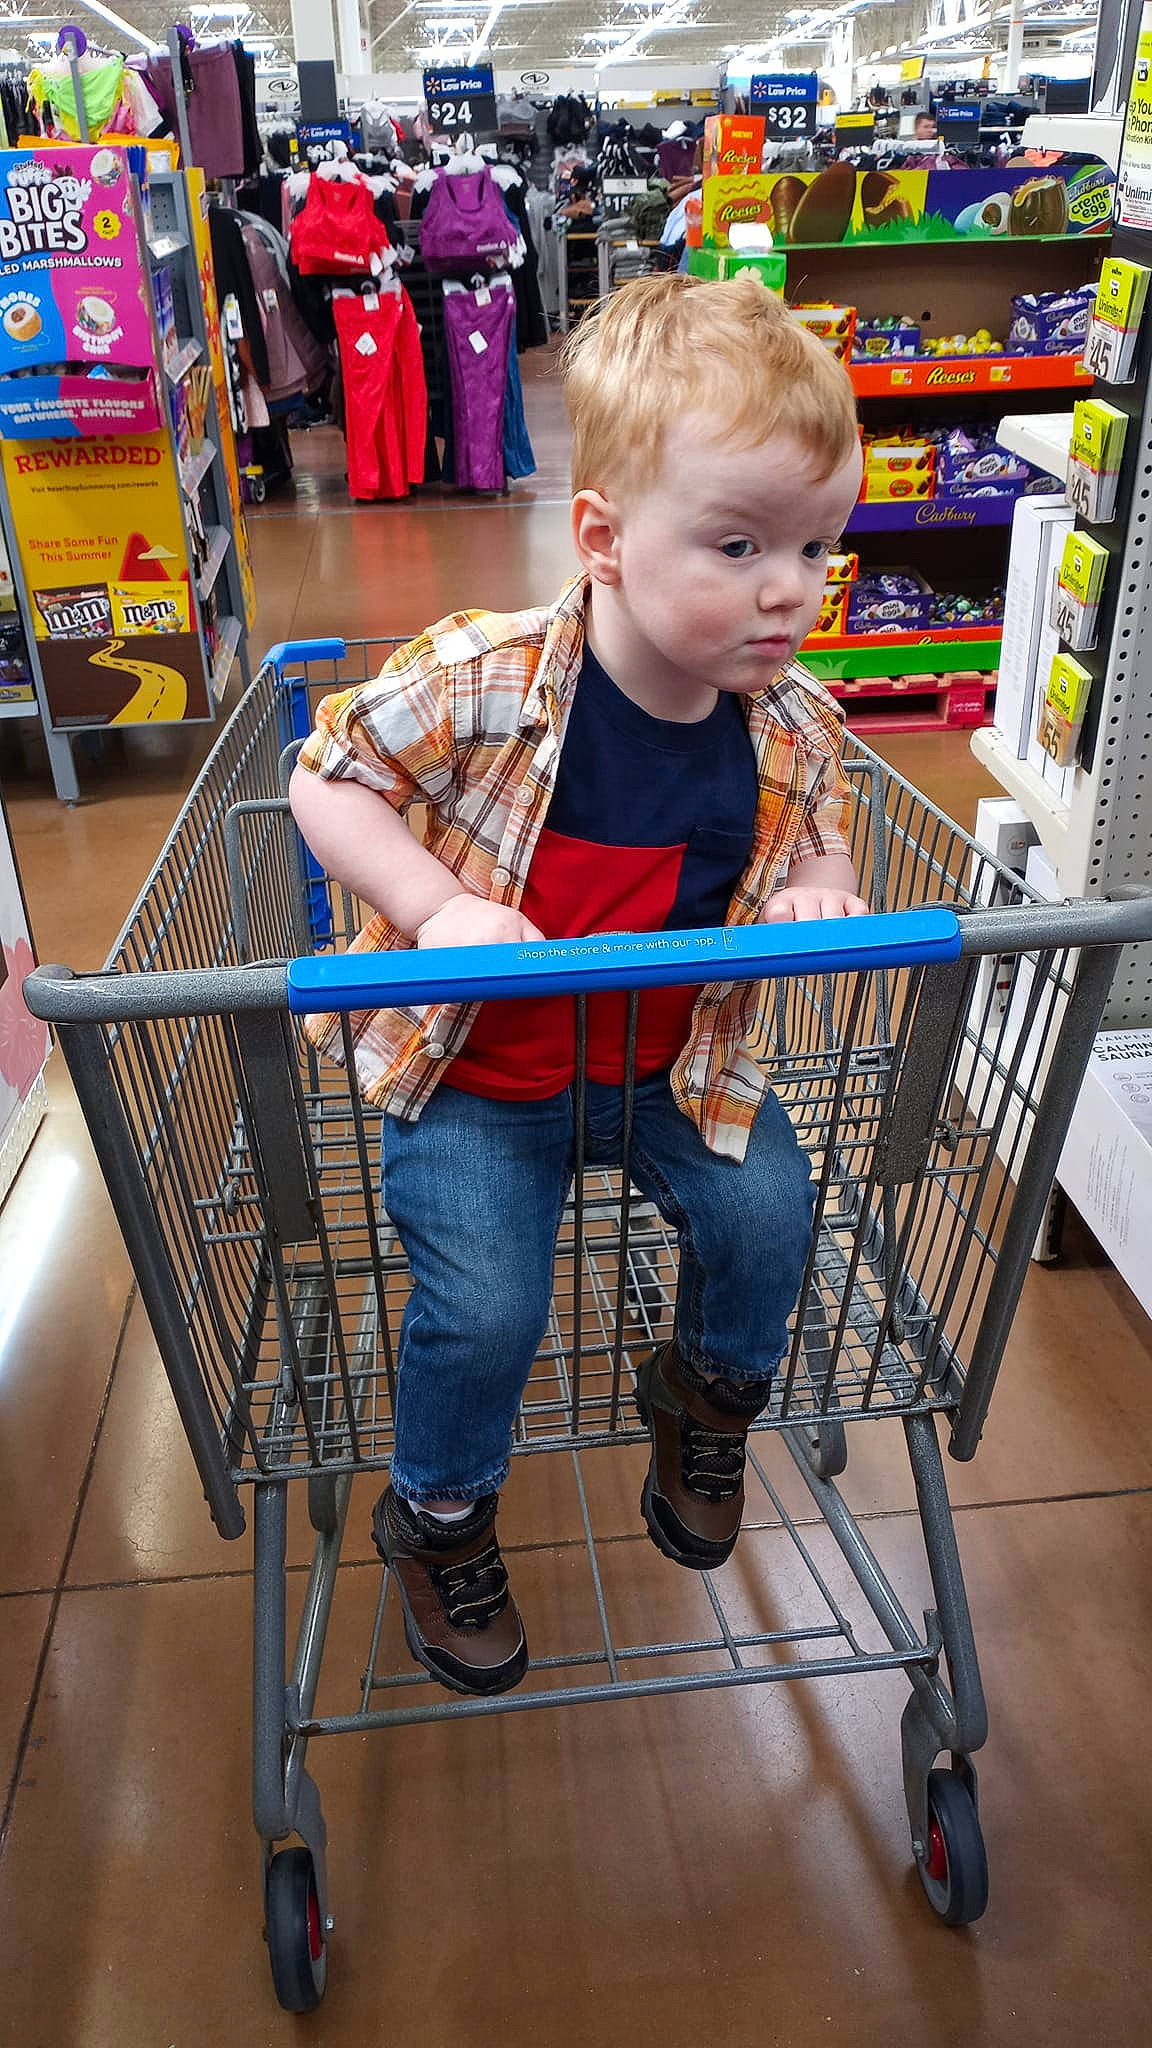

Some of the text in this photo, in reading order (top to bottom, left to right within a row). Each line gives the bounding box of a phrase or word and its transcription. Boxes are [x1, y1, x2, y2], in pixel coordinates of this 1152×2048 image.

[441, 81, 482, 91] Low Price
[768, 86, 807, 96] Low Price
[431, 101, 472, 125] $24
[769, 106, 807, 129] $32
[7, 183, 64, 223] BIG
[1071, 189, 1110, 214] creme
[1082, 201, 1106, 218] egg
[721, 204, 760, 222] Reese's
[102, 217, 111, 229] 2
[0, 212, 86, 259] BITES
[23, 257, 122, 271] MARSHMALLOWS
[1090, 337, 1112, 378] $45
[927, 366, 976, 385] Reese's
[1, 400, 145, 415] YOUR FAVORITE FLAVORS
[14, 408, 136, 424] ANYWHERE, ANYTIME.
[14, 446, 161, 474] REWARDED
[1072, 474, 1091, 516] $45
[915, 503, 977, 526] Cadbury
[29, 536, 118, 550] Share Some Fun
[40, 551, 112, 563] This Summer
[882, 609, 901, 622] eggs
[883, 602, 900, 611] mini
[1057, 602, 1075, 642] $45
[517, 949, 547, 960] Shop
[549, 948, 567, 956] the
[570, 945, 599, 955] store
[602, 944, 610, 952] &
[613, 942, 643, 950] more
[645, 939, 669, 949] with
[672, 938, 690, 947] our
[1098, 1051, 1152, 1061] SAUNA
